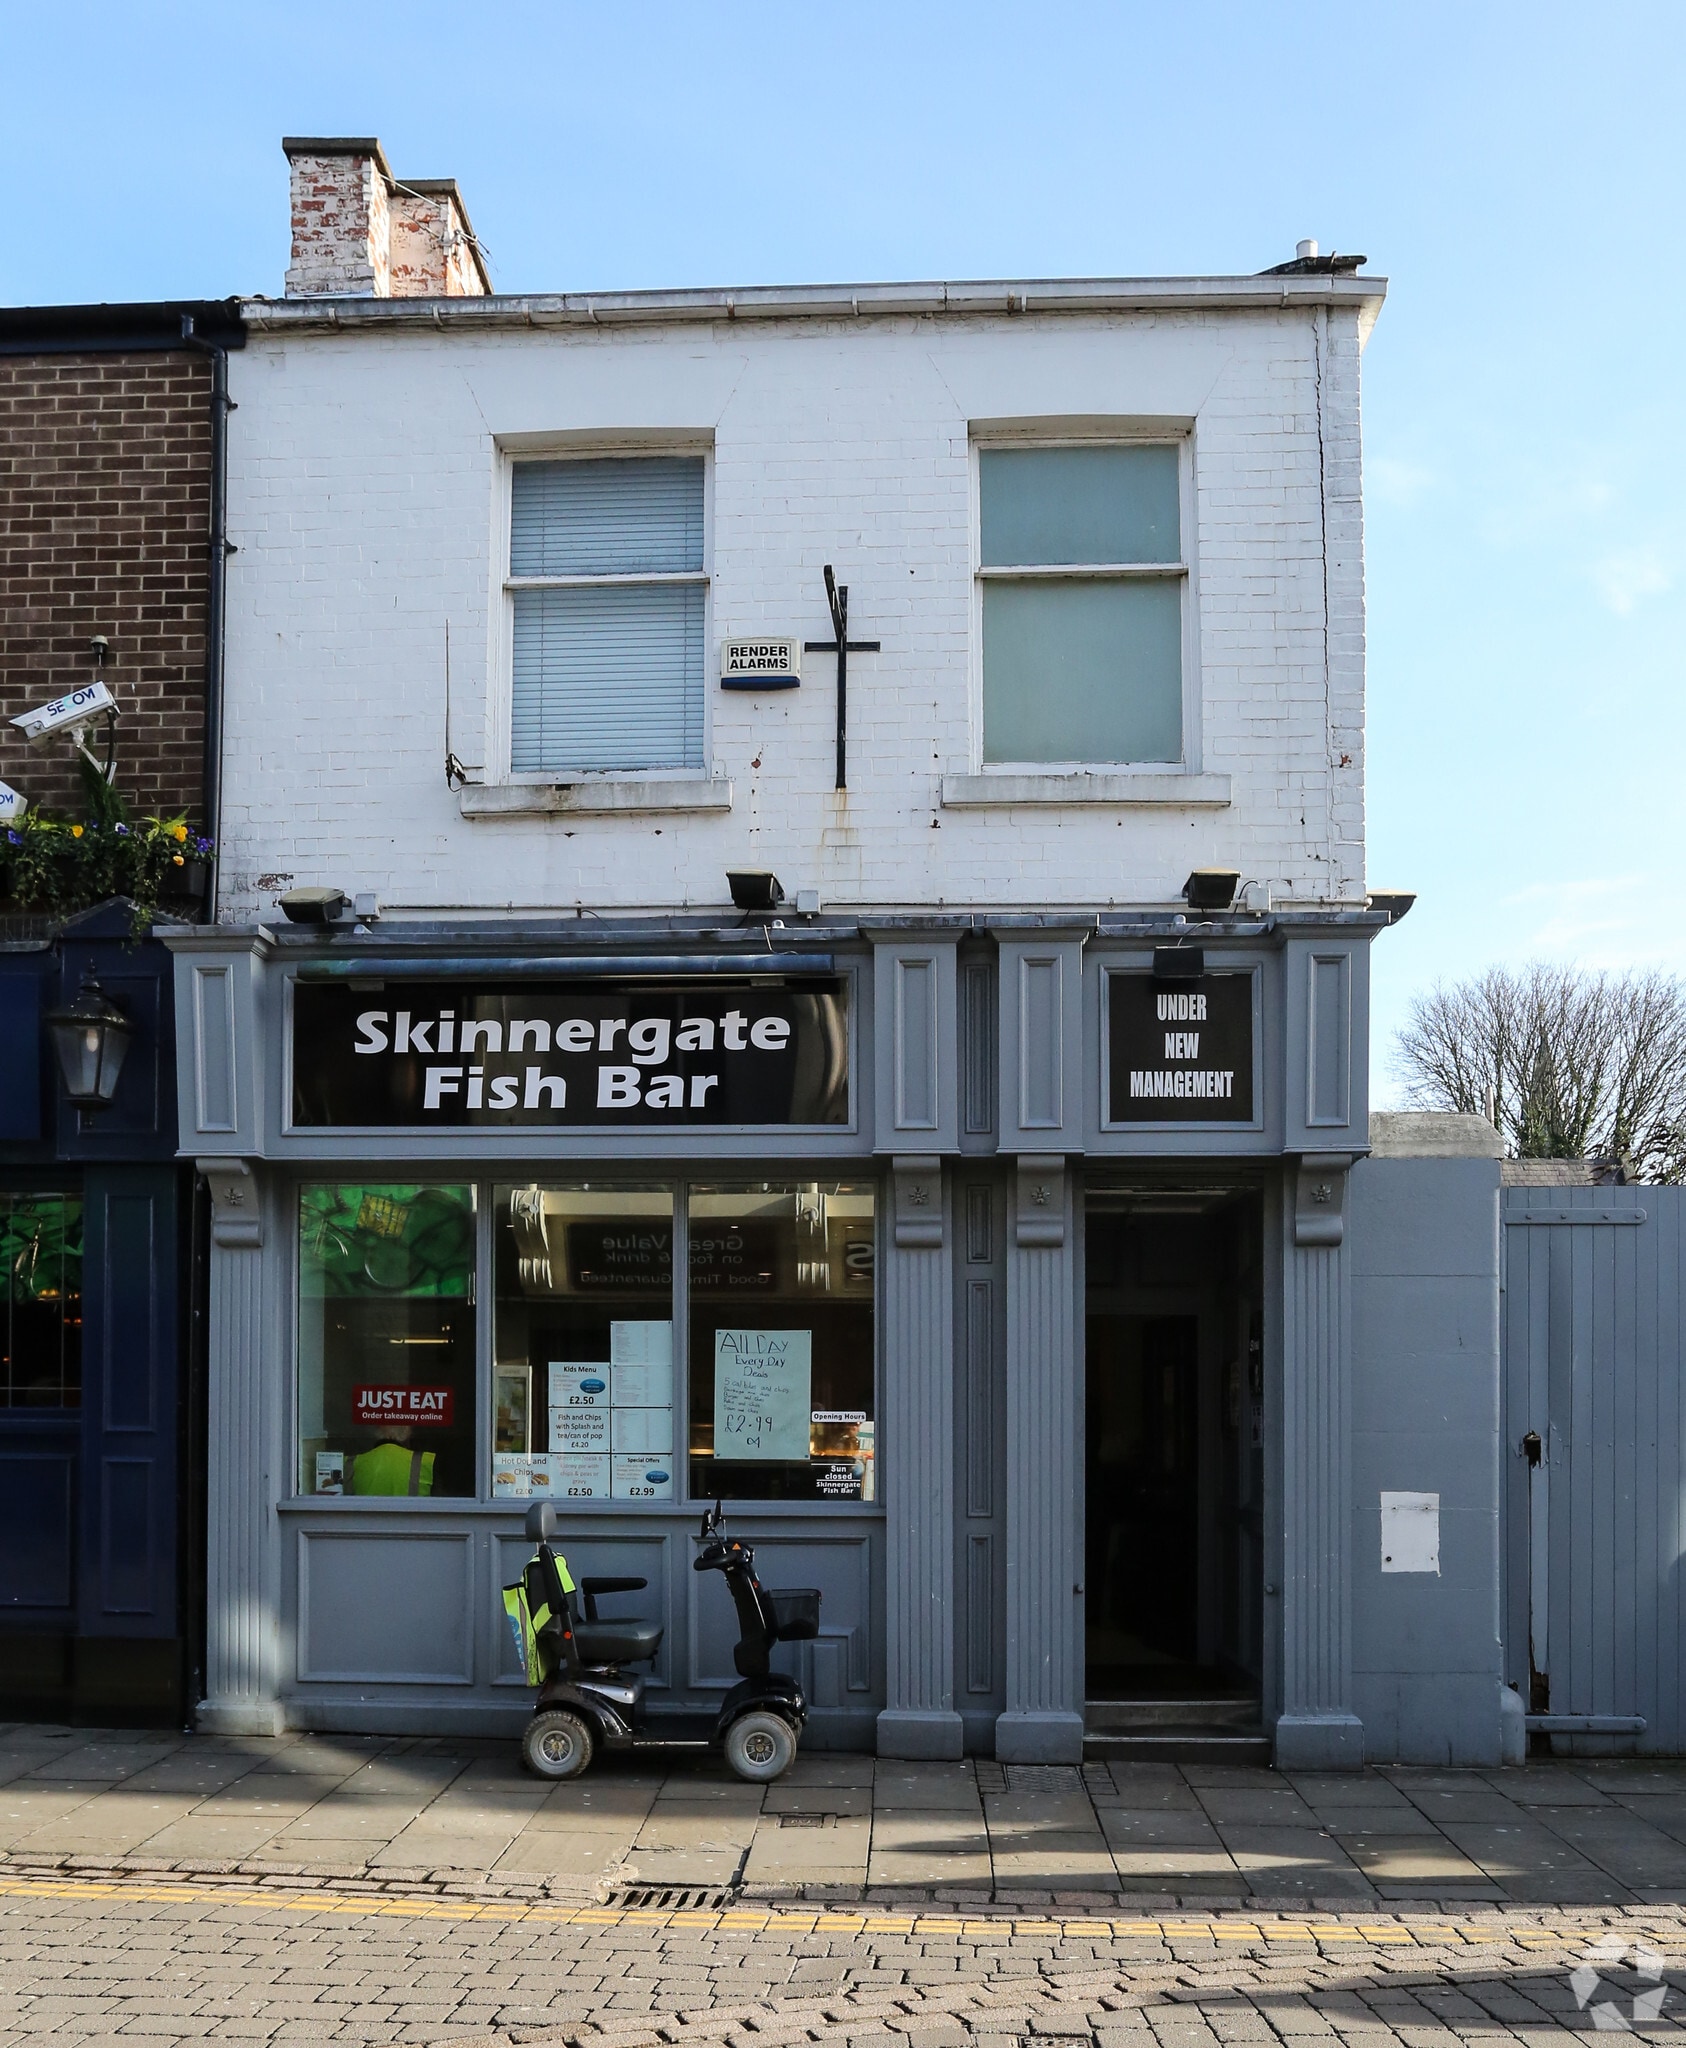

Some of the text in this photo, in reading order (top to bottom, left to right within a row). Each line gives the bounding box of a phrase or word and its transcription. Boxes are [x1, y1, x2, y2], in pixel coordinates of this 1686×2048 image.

[730, 646, 788, 657] RENDER
[730, 658, 788, 670] ALARMS
[47, 688, 96, 717] SECOM
[1156, 994, 1207, 1021] UNDER
[353, 1009, 791, 1065] Skinnergate
[1164, 1032, 1200, 1059] NEW
[423, 1065, 719, 1110] Fish Bar
[1130, 1070, 1234, 1098] MANAGEMENT
[720, 1332, 749, 1355] All
[735, 1354, 764, 1369] Every
[357, 1390, 448, 1409] JUST EAT
[569, 1396, 595, 1405] £2.50
[362, 1411, 383, 1419] Order
[384, 1412, 419, 1421] takeaway
[584, 1414, 602, 1422] Chips
[571, 1423, 591, 1431] Splash
[724, 1414, 773, 1433] £2.99
[590, 1433, 603, 1441] pop
[501, 1457, 515, 1465] Hot
[532, 1456, 547, 1465] and
[514, 1468, 534, 1477] Chips
[824, 1472, 853, 1480] closed
[567, 1487, 593, 1496] £2.50
[629, 1487, 655, 1496] £2.99
